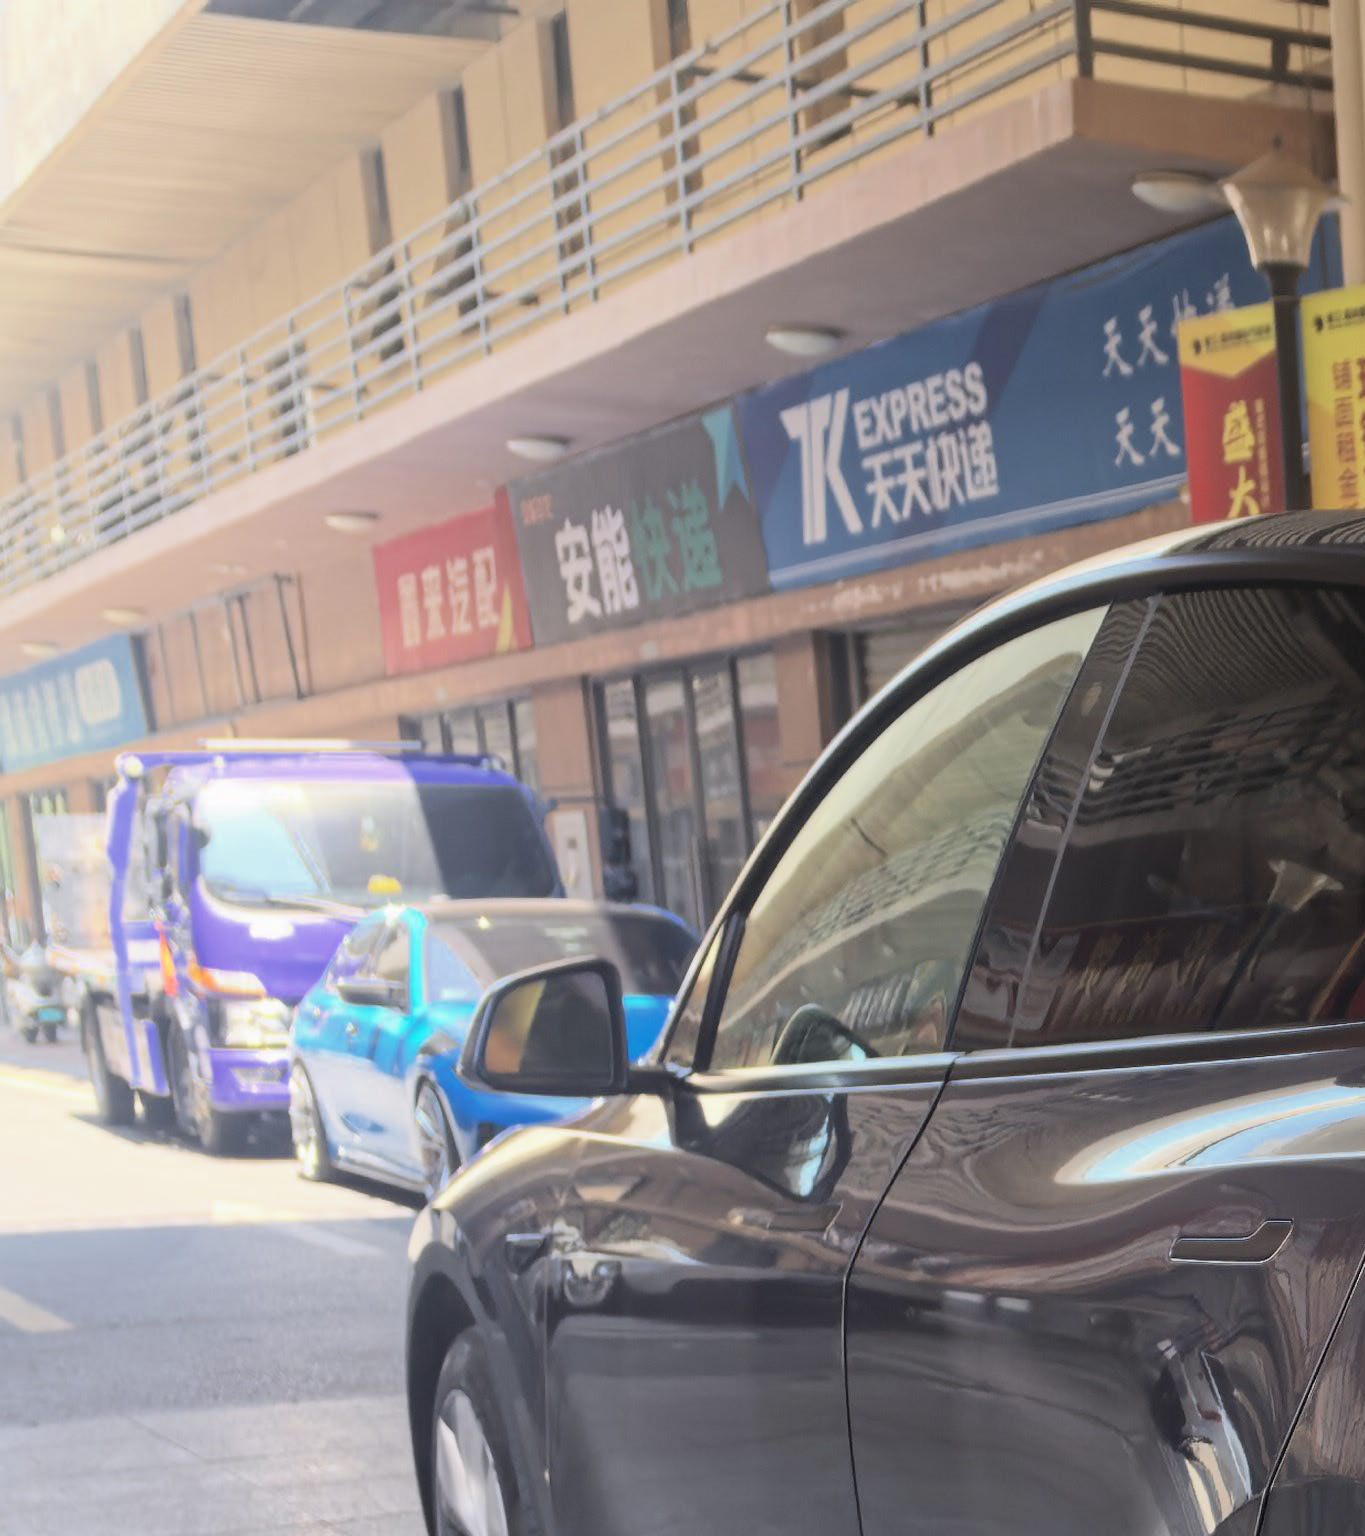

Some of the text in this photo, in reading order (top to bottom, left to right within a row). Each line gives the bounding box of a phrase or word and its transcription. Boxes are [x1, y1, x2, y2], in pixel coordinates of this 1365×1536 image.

[853, 361, 987, 449] EXPRESS
[861, 420, 999, 528] 天天快递
